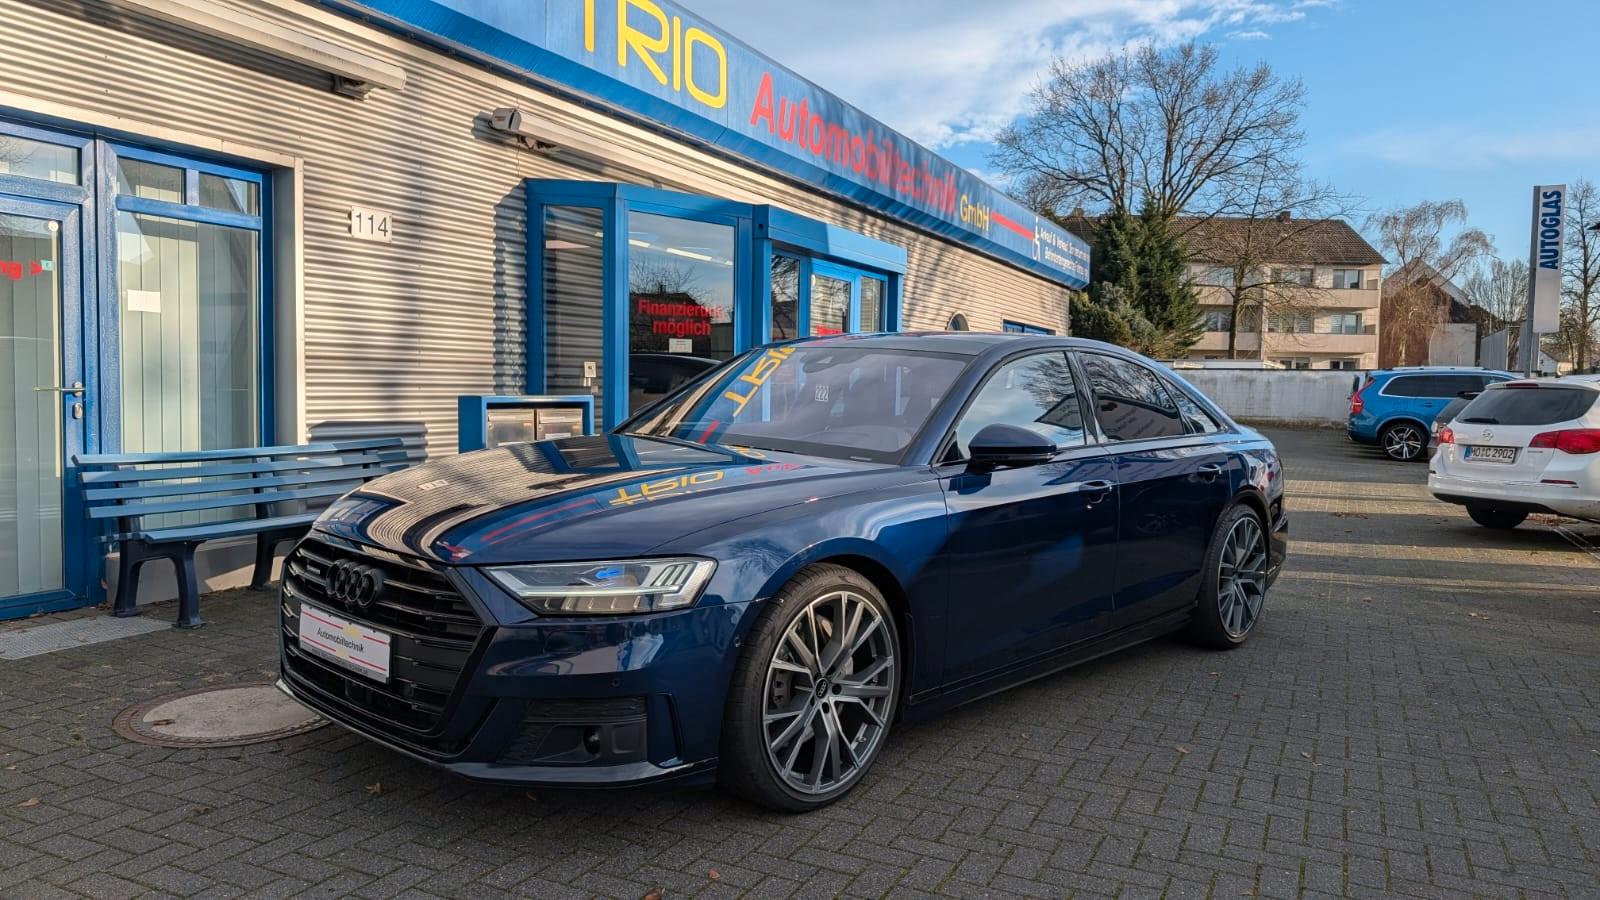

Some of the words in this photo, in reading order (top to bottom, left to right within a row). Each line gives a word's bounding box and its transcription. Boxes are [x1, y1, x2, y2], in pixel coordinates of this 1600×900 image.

[750, 71, 958, 216] Automobiltechnik
[959, 194, 990, 233] GmbH
[355, 212, 389, 238] 114
[1539, 190, 1562, 270] AUTOGLAS
[652, 318, 711, 337] möglich
[316, 627, 365, 653] Automobiltechnik
